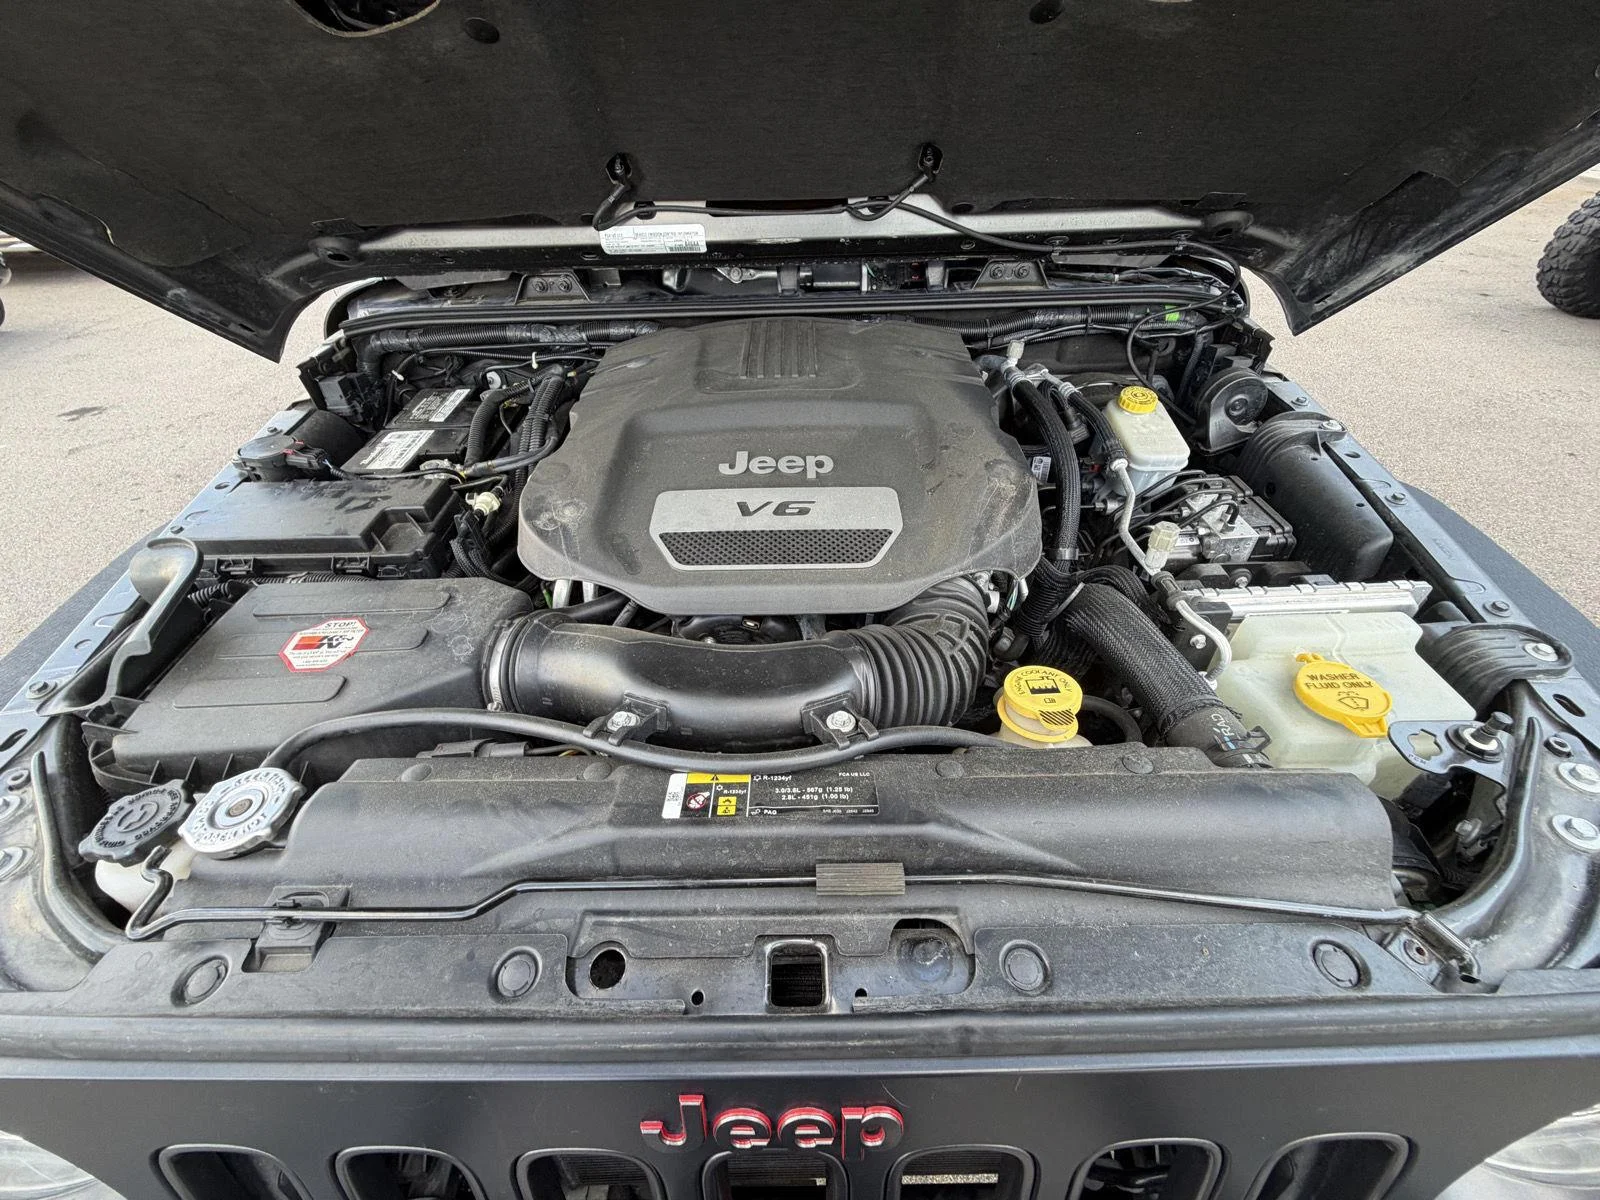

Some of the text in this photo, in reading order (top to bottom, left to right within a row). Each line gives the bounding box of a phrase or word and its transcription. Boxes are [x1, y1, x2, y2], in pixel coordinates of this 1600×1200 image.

[718, 451, 834, 479] Jeep
[737, 500, 816, 517] V6
[1021, 670, 1058, 678] COOLANT
[1060, 678, 1072, 692] ONLY
[1306, 673, 1360, 681] WASHER
[640, 1095, 904, 1161] Jeep
